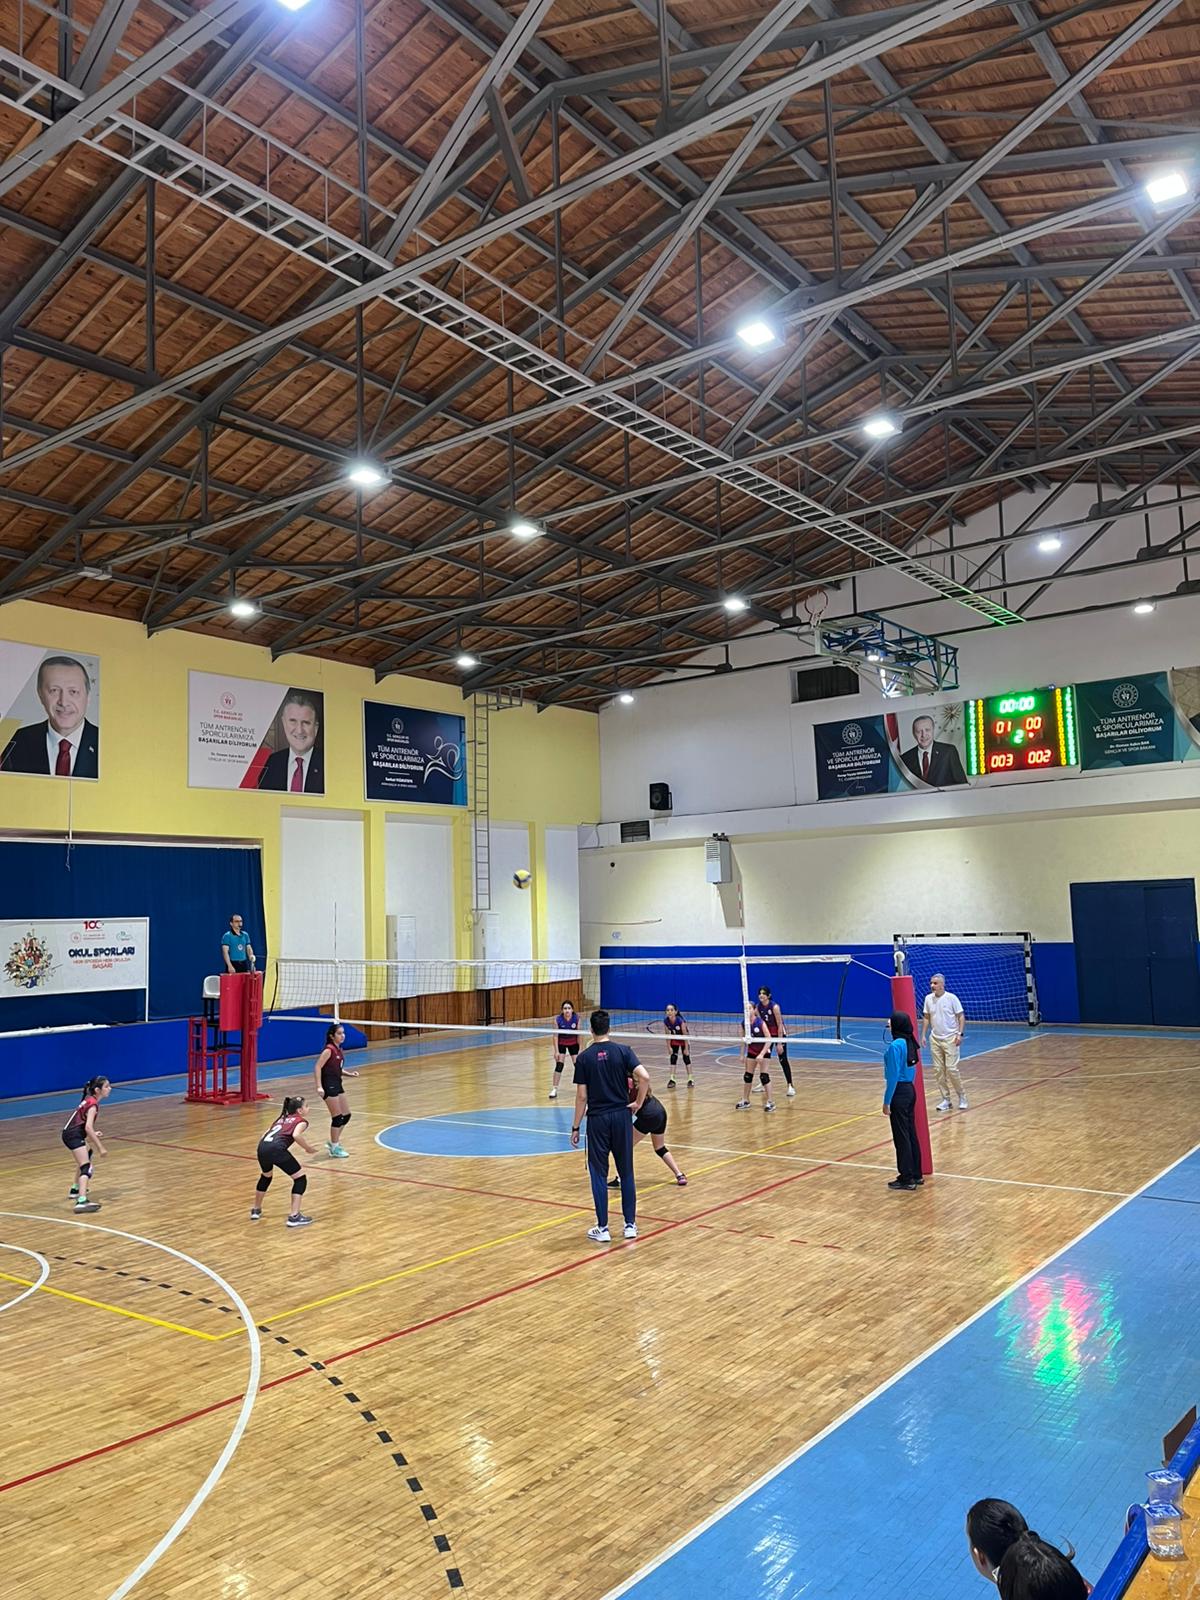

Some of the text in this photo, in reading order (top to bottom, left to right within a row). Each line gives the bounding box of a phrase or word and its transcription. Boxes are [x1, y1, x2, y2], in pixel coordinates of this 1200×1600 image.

[1000, 696, 1035, 714] 00:00
[1100, 712, 1156, 725] TÜM ANTRENÖR
[1102, 718, 1164, 731] SPORCULARIMIZA
[200, 721, 214, 729] TÜM
[215, 724, 247, 733] ANTRENÖR
[996, 716, 1042, 734] 01 00
[201, 729, 254, 741] SPORCULARIMIZA
[1013, 729, 1024, 744] 2
[1096, 726, 1162, 739] BAŞARILAR DİLİYORUM
[198, 736, 228, 745] BAŞARILAR
[371, 751, 425, 763] VE SPORCULARIMIZA
[391, 747, 419, 756] ANTRENÖR
[845, 747, 875, 756] ANTRENÖR
[834, 752, 881, 764] SPORCULARIMIZA
[991, 749, 1052, 768] 003 002
[373, 760, 399, 769] BAŞARILAR
[828, 762, 854, 770] BAŞARILAR
[68, 946, 136, 958] OKUL SPORLARI
[264, 1124, 282, 1142] 2
